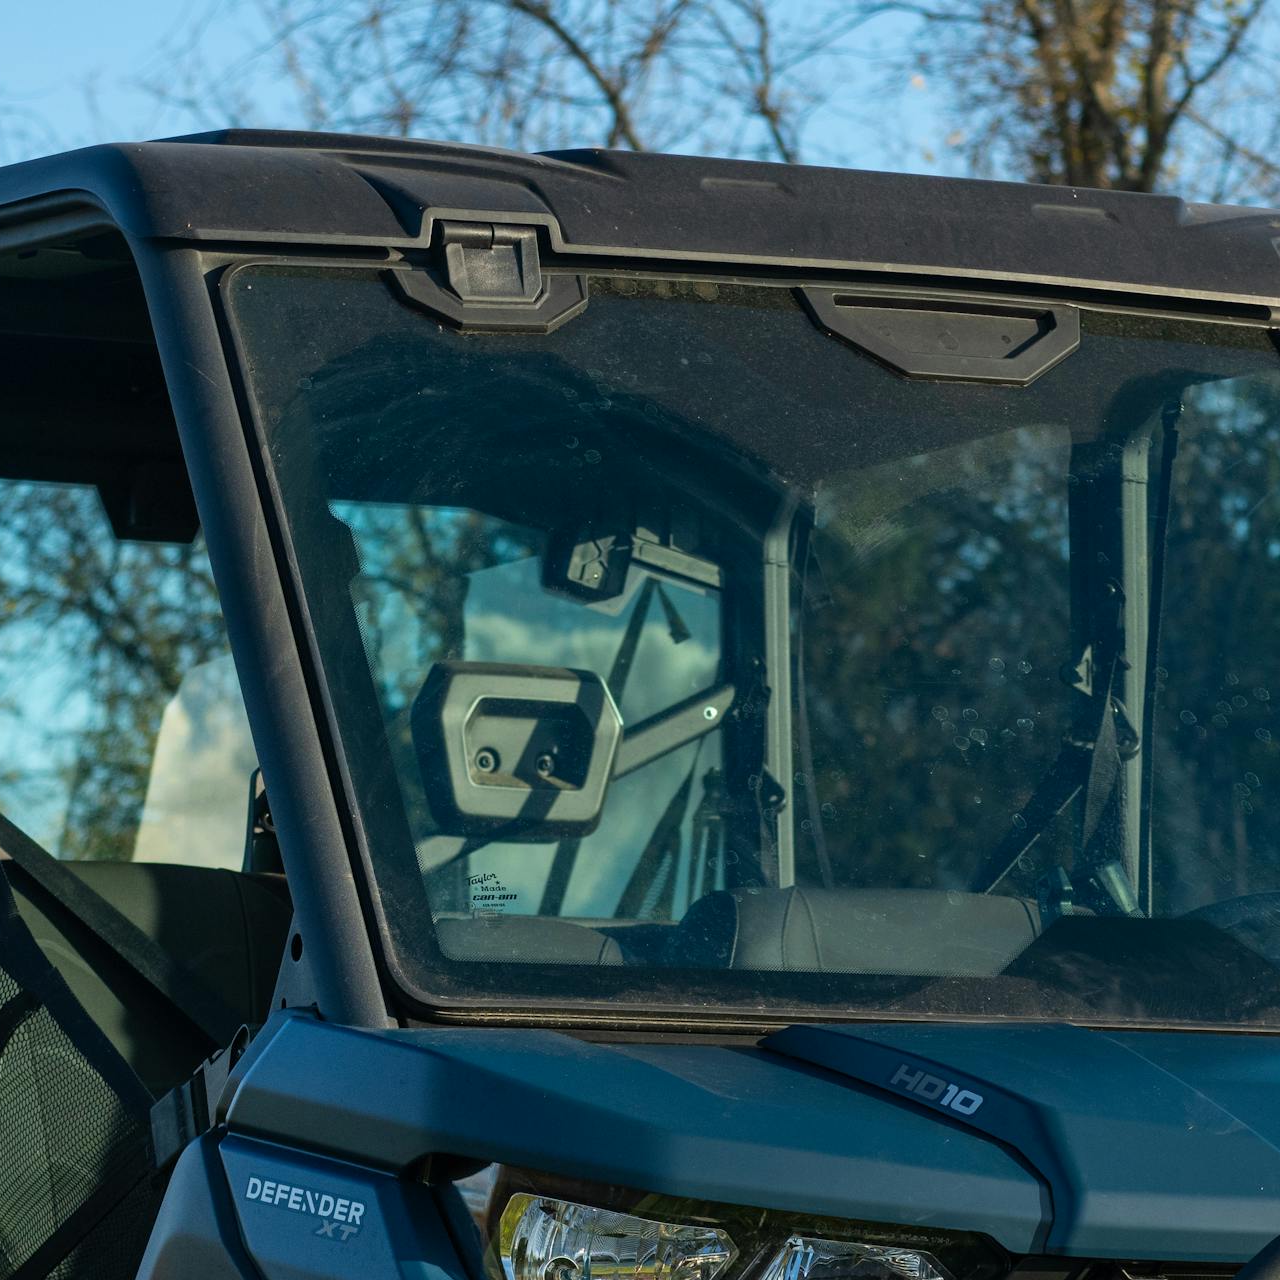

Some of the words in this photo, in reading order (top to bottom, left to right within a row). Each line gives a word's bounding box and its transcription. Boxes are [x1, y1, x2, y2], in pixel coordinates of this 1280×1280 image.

[464, 873, 497, 886] Taylor
[889, 1063, 984, 1117] HD10
[246, 1176, 366, 1226] DEFENDER
[315, 1218, 359, 1242] XT
